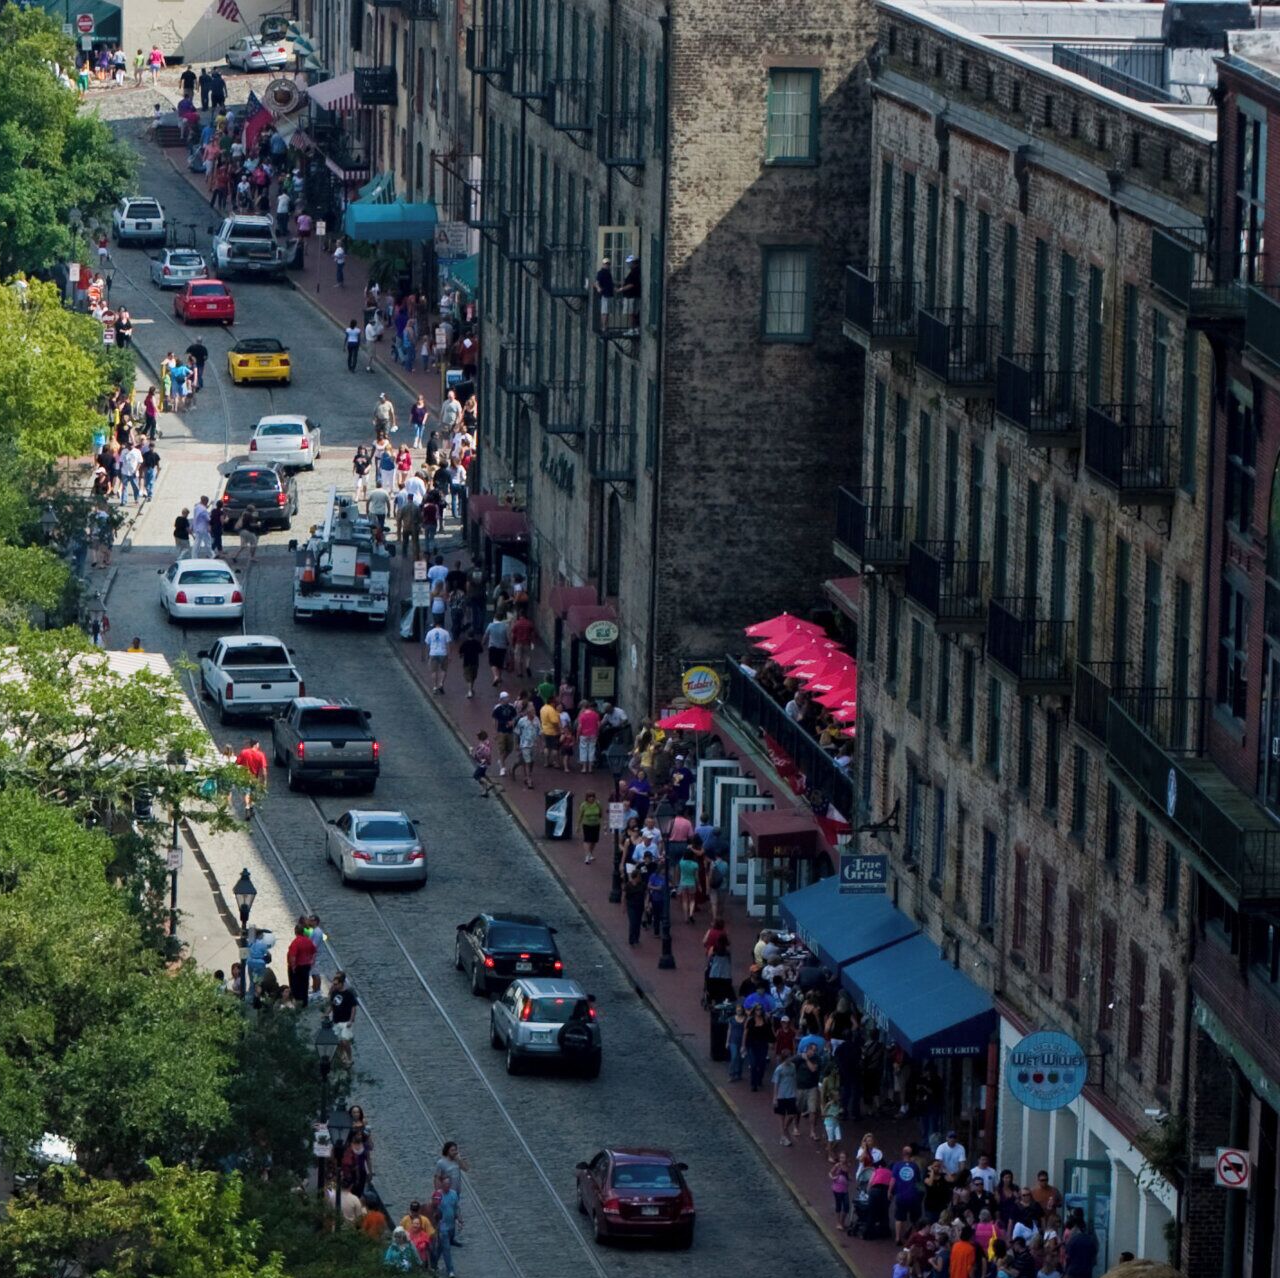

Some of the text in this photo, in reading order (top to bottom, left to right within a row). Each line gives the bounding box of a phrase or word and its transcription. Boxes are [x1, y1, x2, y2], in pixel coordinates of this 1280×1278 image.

[853, 858, 882, 871] True
[843, 864, 883, 880] Grits
[929, 1046, 981, 1056] TRUE GRITS
